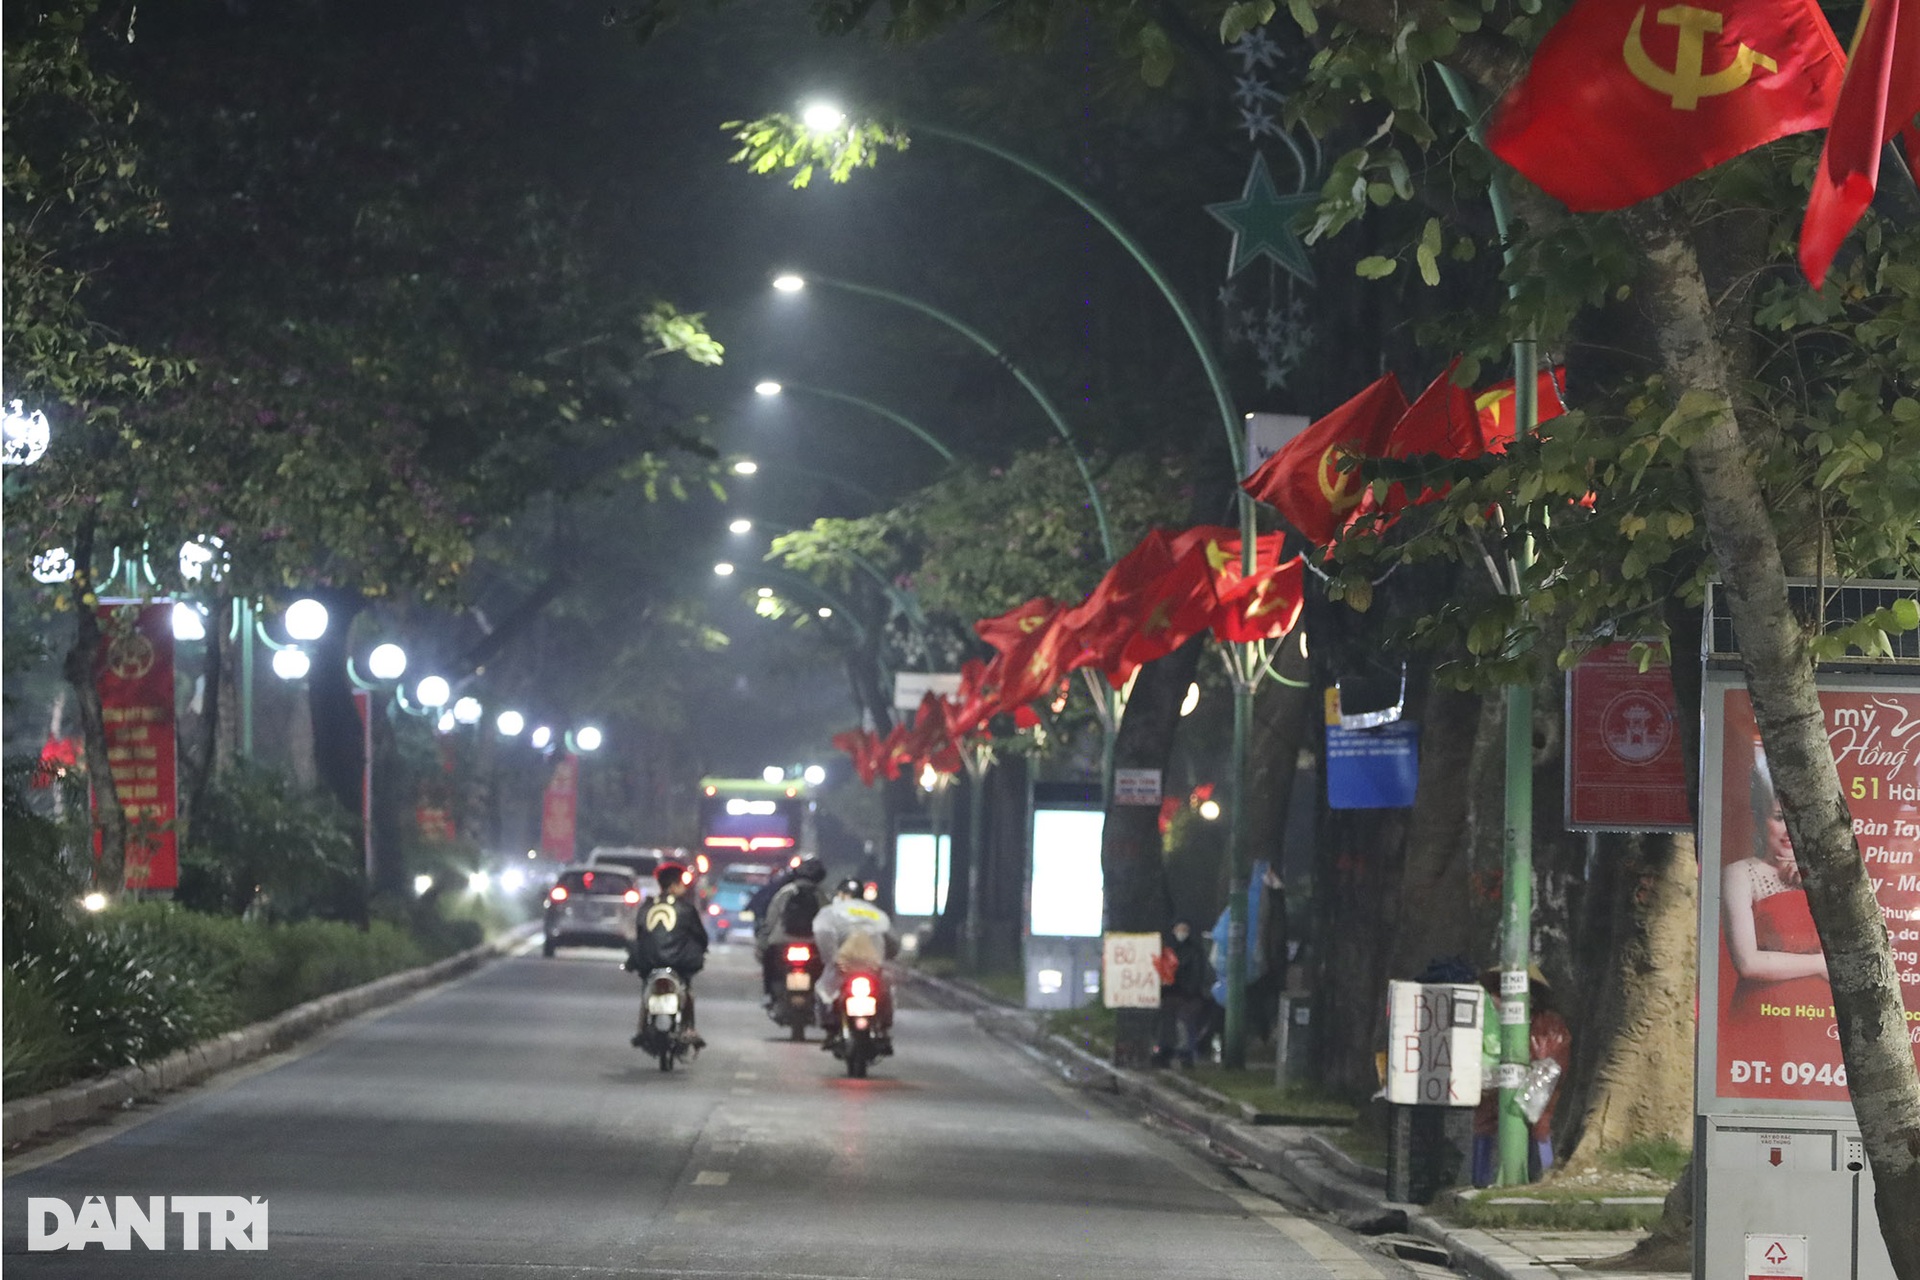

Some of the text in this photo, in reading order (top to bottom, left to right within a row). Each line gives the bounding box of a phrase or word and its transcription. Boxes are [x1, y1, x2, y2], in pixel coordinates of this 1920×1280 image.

[1850, 776, 1879, 800] 51
[1852, 817, 1889, 836] Bàn
[1864, 846, 1914, 864] Phun
[1760, 1003, 1791, 1017] Hoa
[1795, 1004, 1825, 1021] Hậu
[1730, 1060, 1771, 1084] ĐT:
